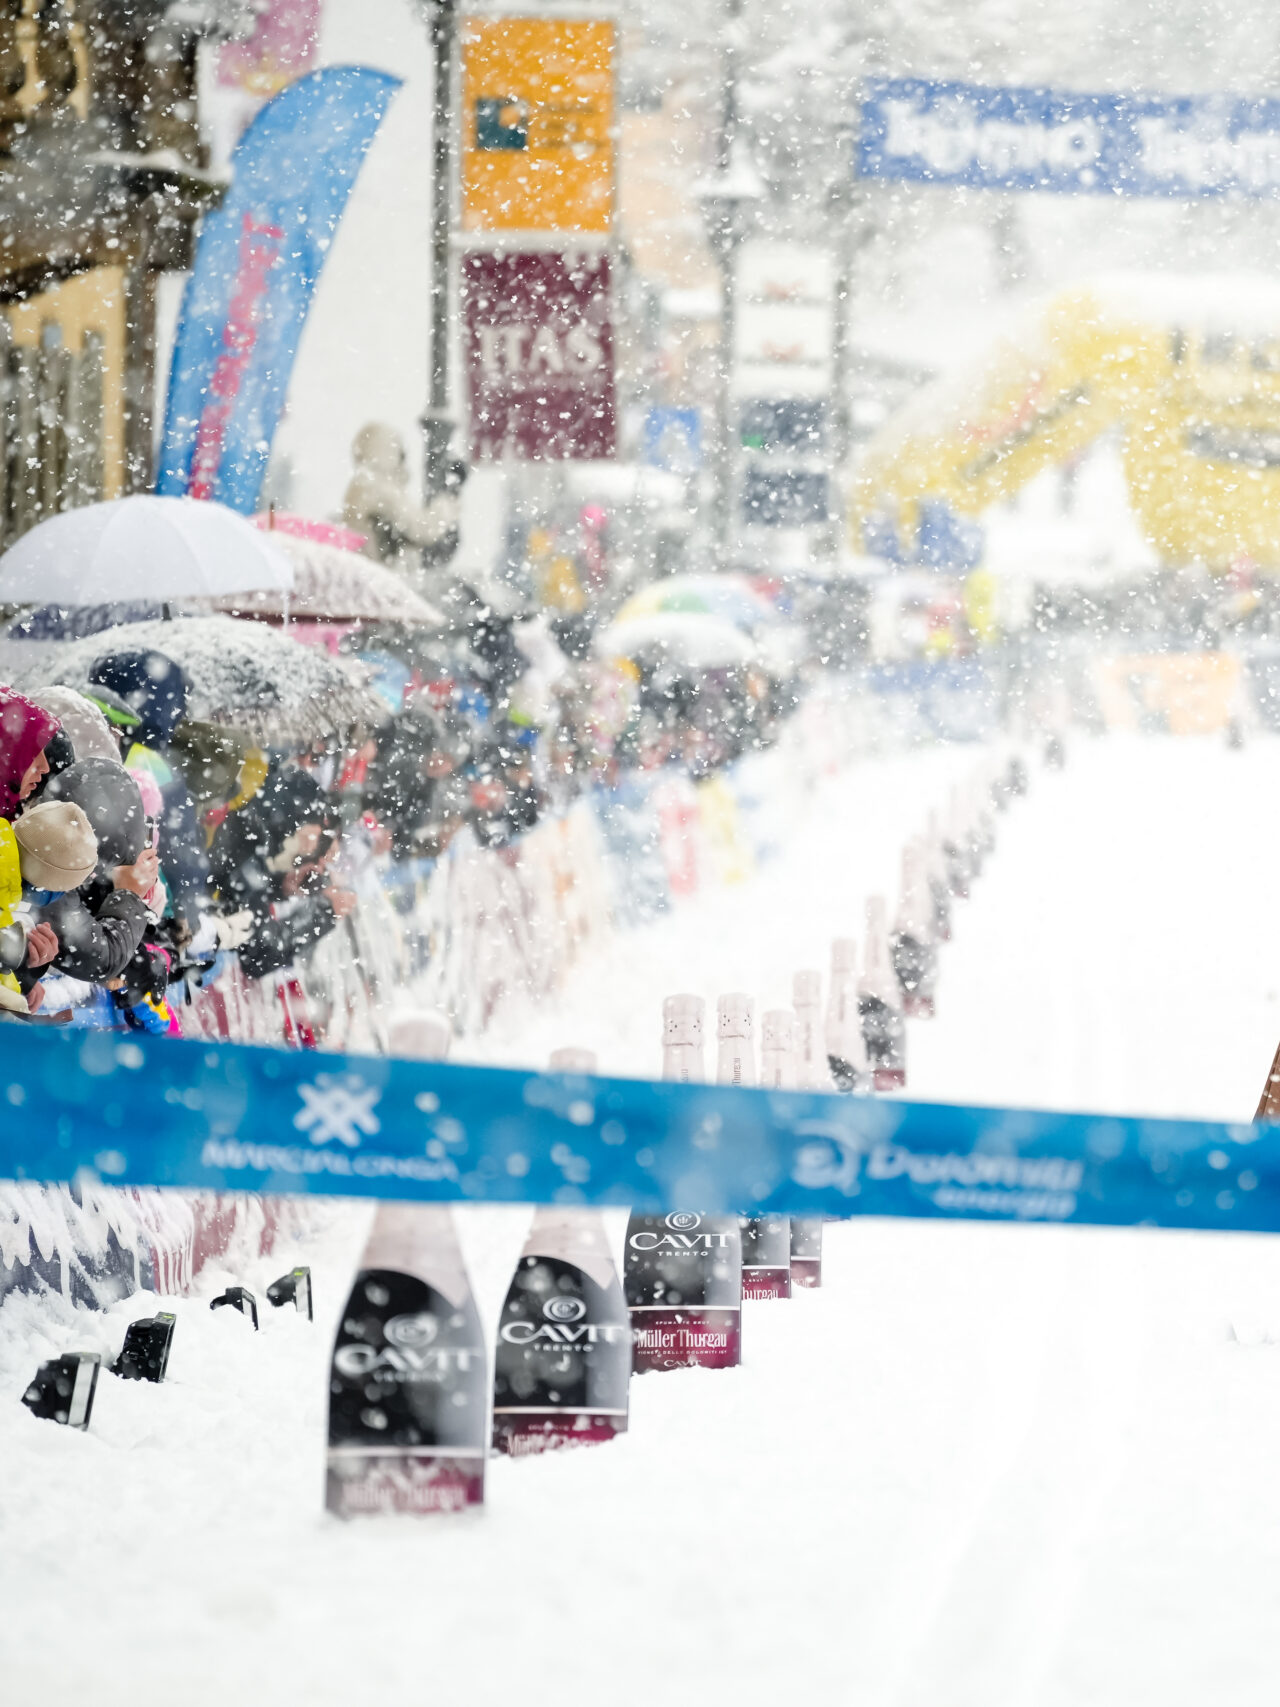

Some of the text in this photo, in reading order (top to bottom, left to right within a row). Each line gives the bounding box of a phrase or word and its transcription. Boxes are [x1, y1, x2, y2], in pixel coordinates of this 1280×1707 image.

[480, 322, 602, 373] ITAS
[629, 1232, 735, 1250] CAVIT
[742, 1286, 778, 1300] hurgau
[501, 1321, 625, 1344] CAVIT
[637, 1329, 727, 1349] Müller Thurgau
[335, 1343, 482, 1375] CAVIT
